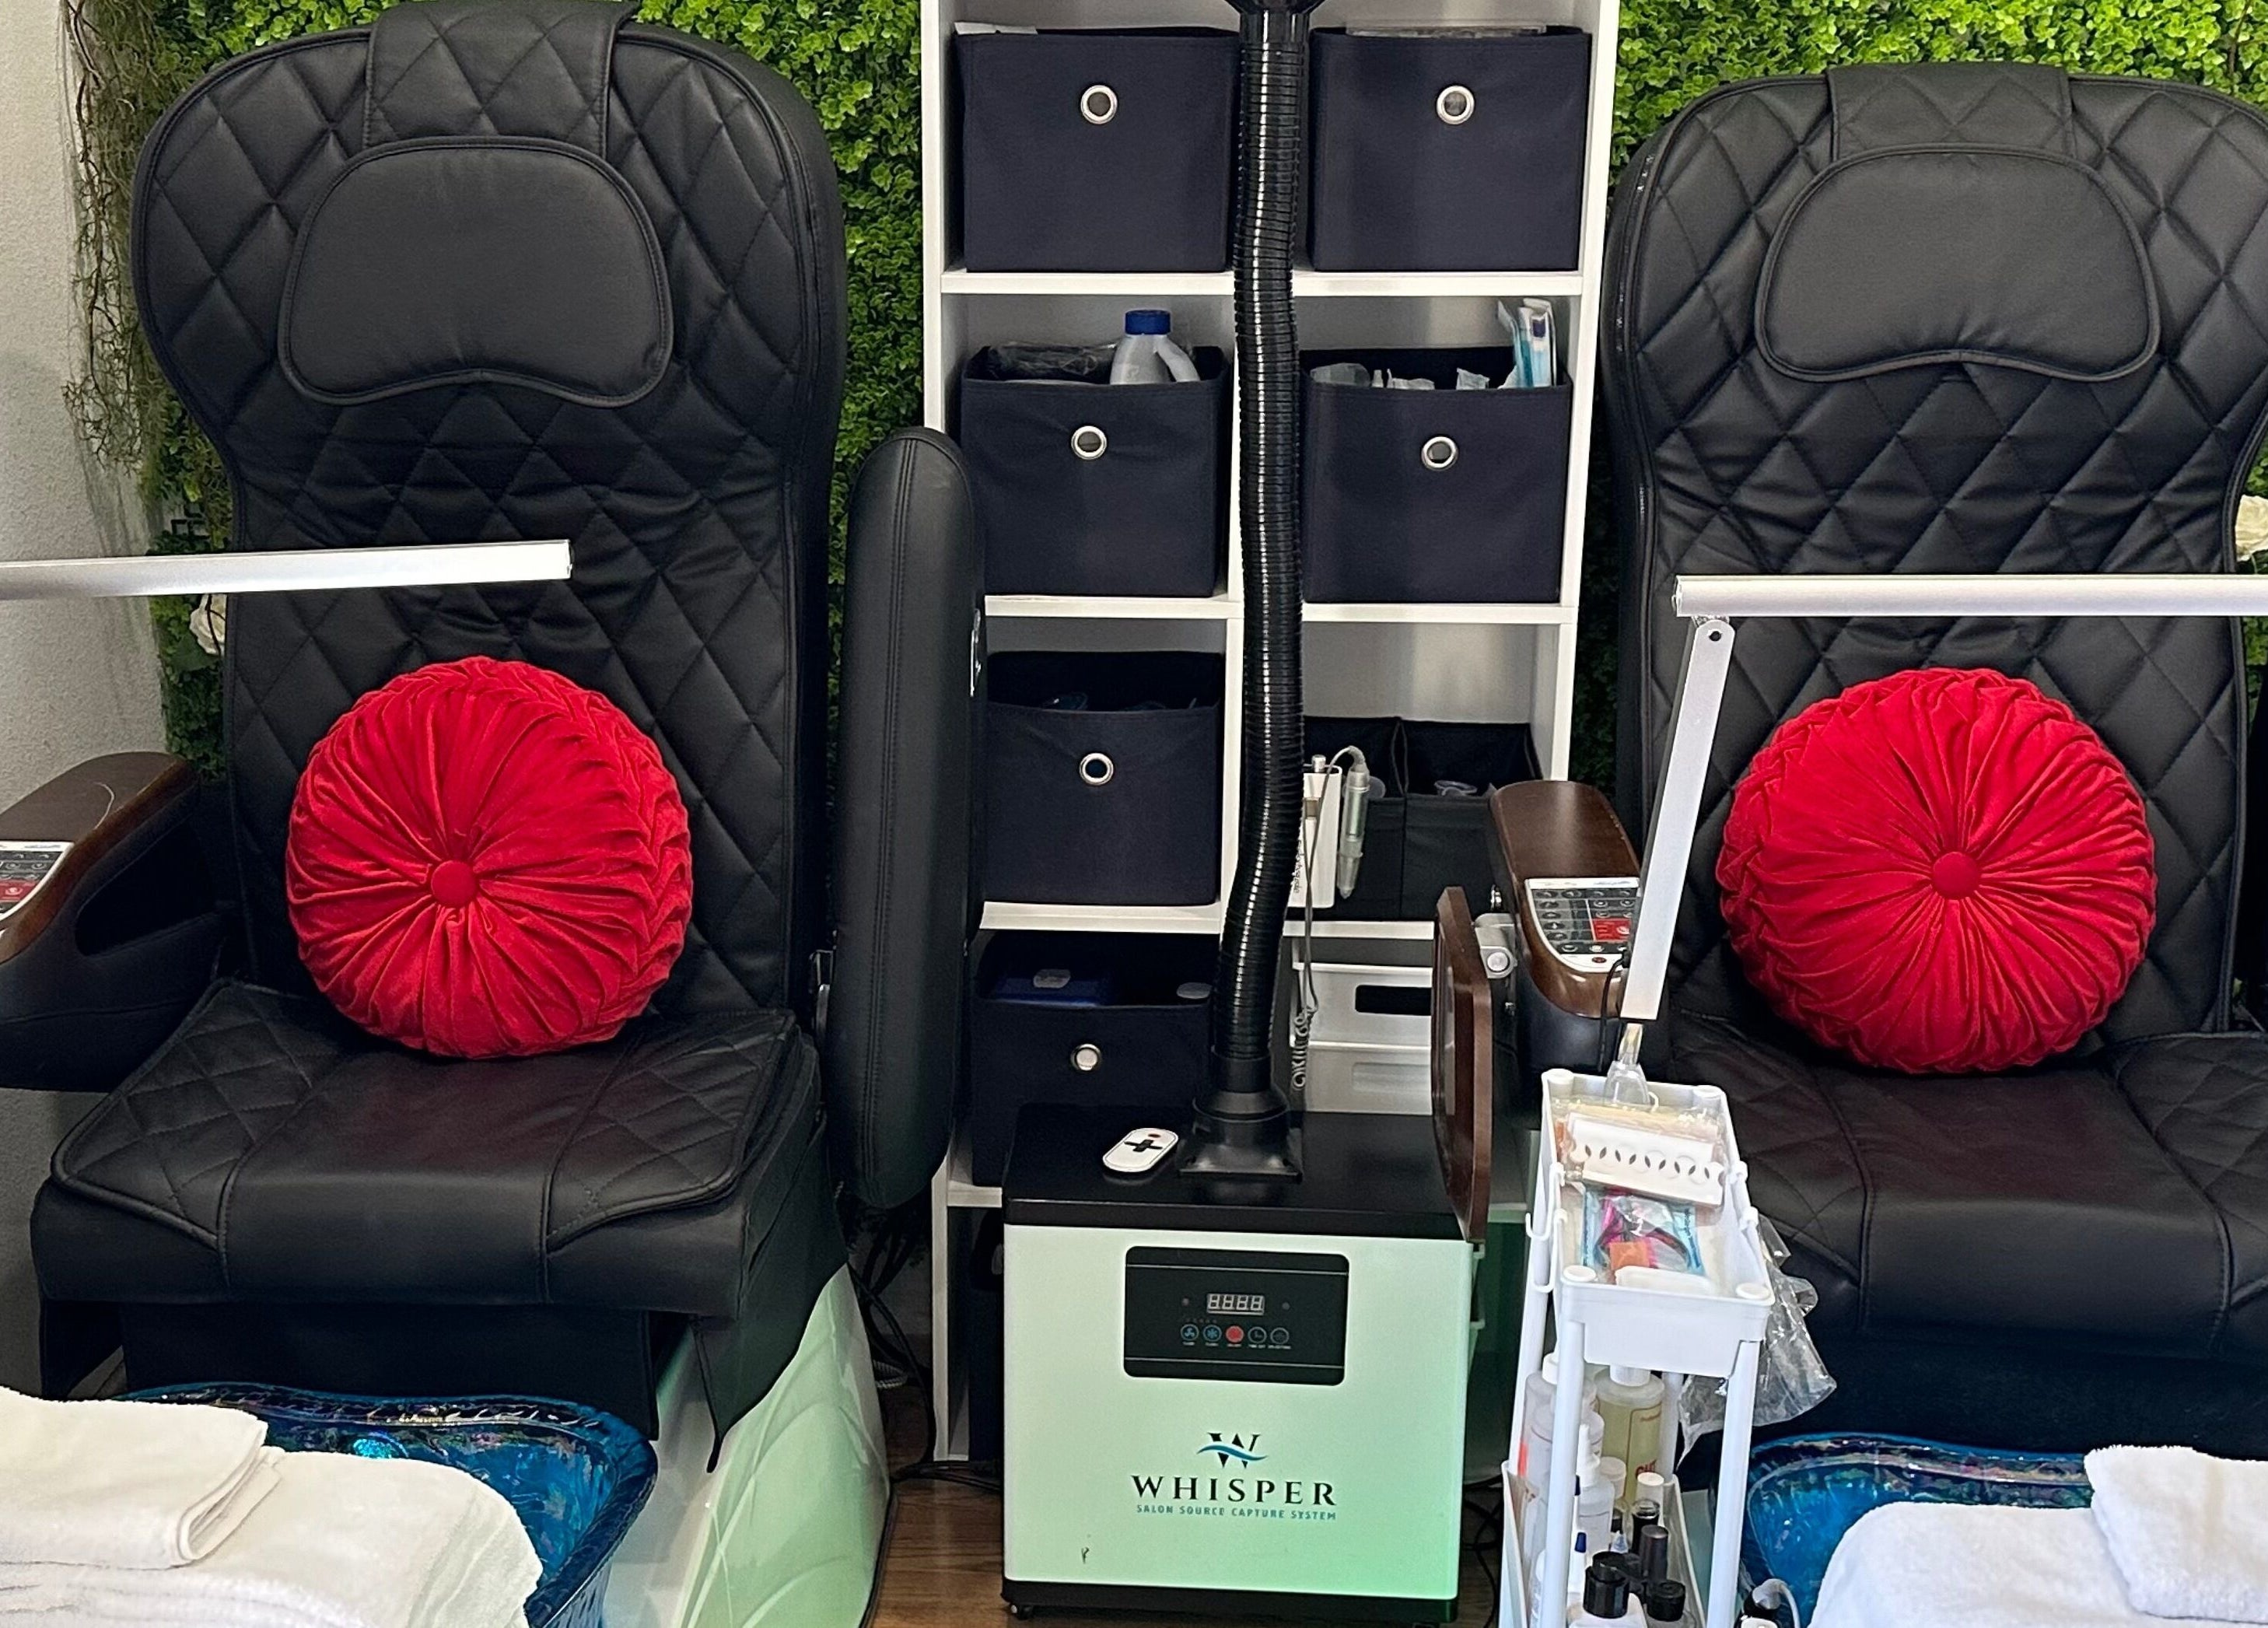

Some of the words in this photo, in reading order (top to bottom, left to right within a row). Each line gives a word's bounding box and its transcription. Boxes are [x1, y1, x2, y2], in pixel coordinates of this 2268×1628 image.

[1130, 1475, 1336, 1506] WHISPER
[1136, 1504, 1174, 1514] SALON
[1179, 1505, 1225, 1516] SOURCE
[1231, 1507, 1285, 1519] CAPTURE
[1291, 1510, 1336, 1520] SYSTEM
